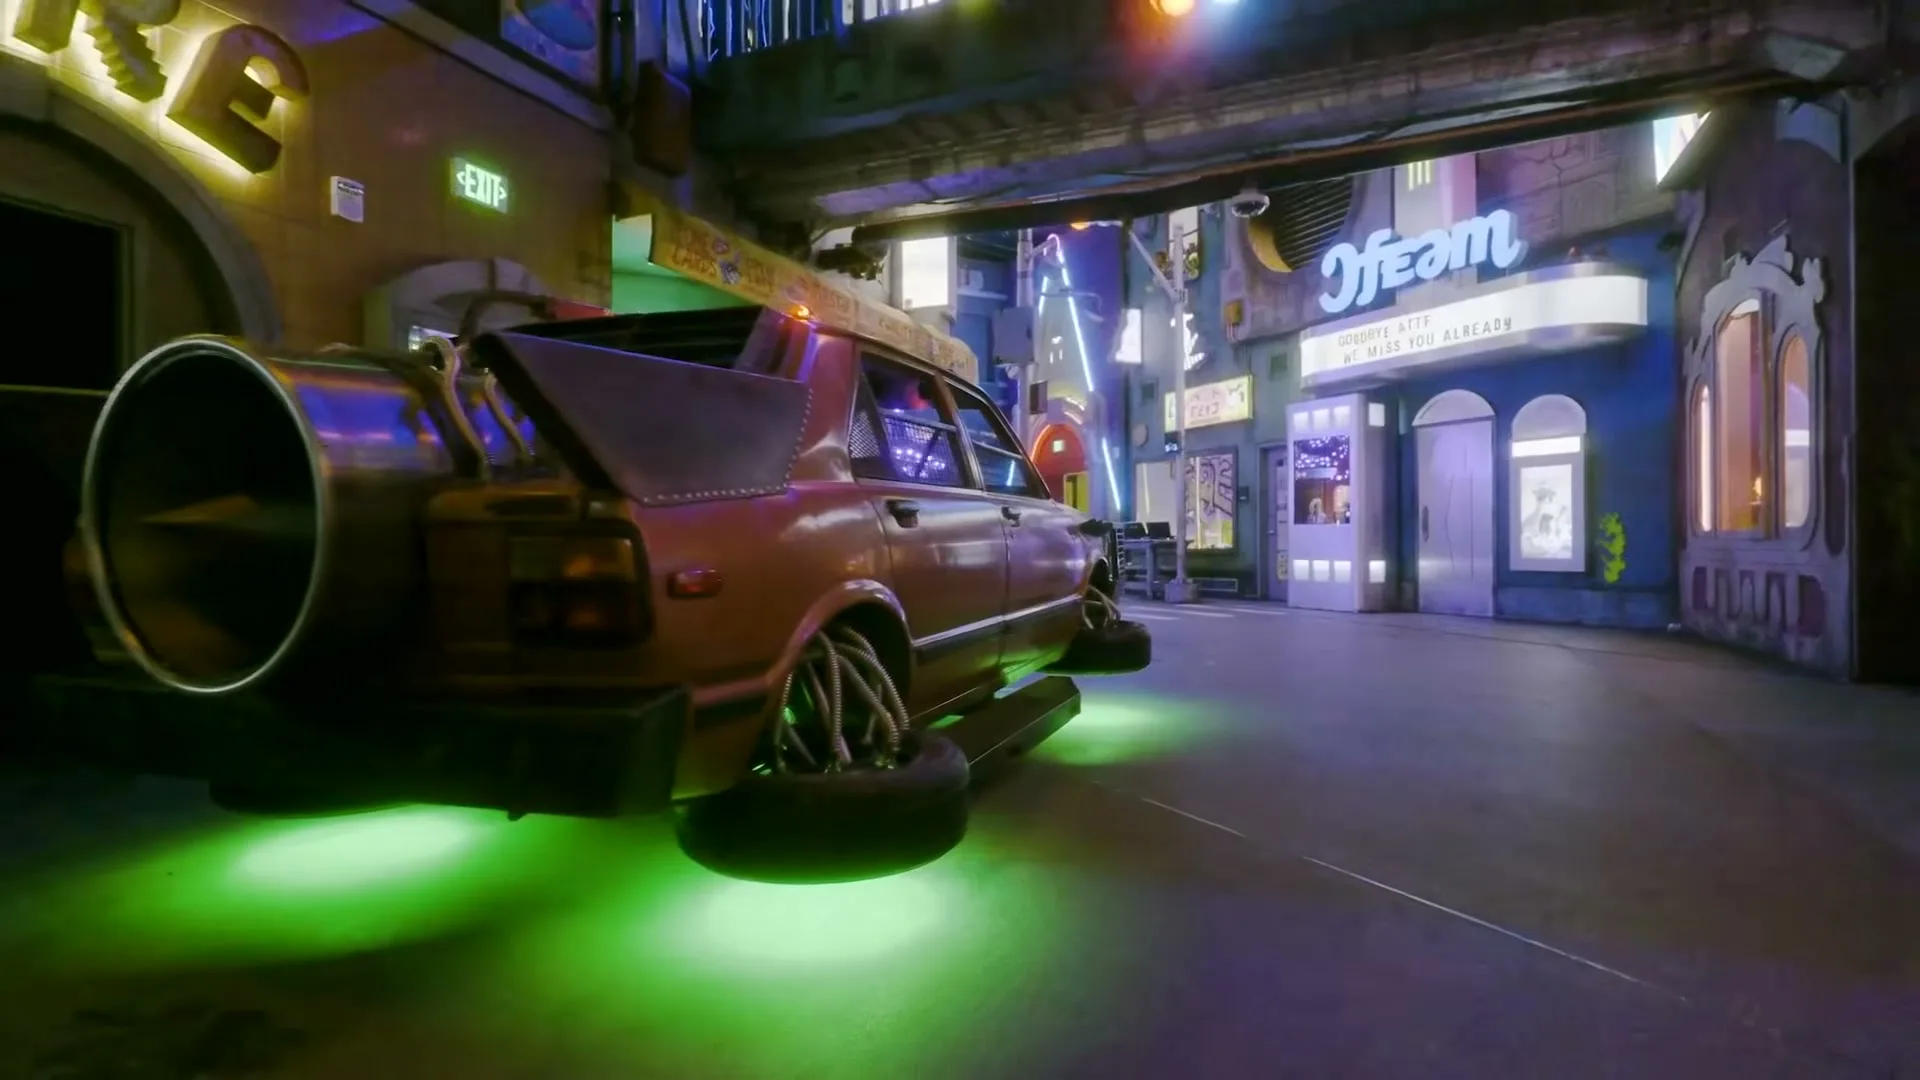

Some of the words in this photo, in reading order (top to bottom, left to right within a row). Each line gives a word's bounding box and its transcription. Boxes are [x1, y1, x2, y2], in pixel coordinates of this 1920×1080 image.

[465, 163, 501, 208] EXIT
[1367, 340, 1401, 358] MISS
[1409, 333, 1434, 348] YOU
